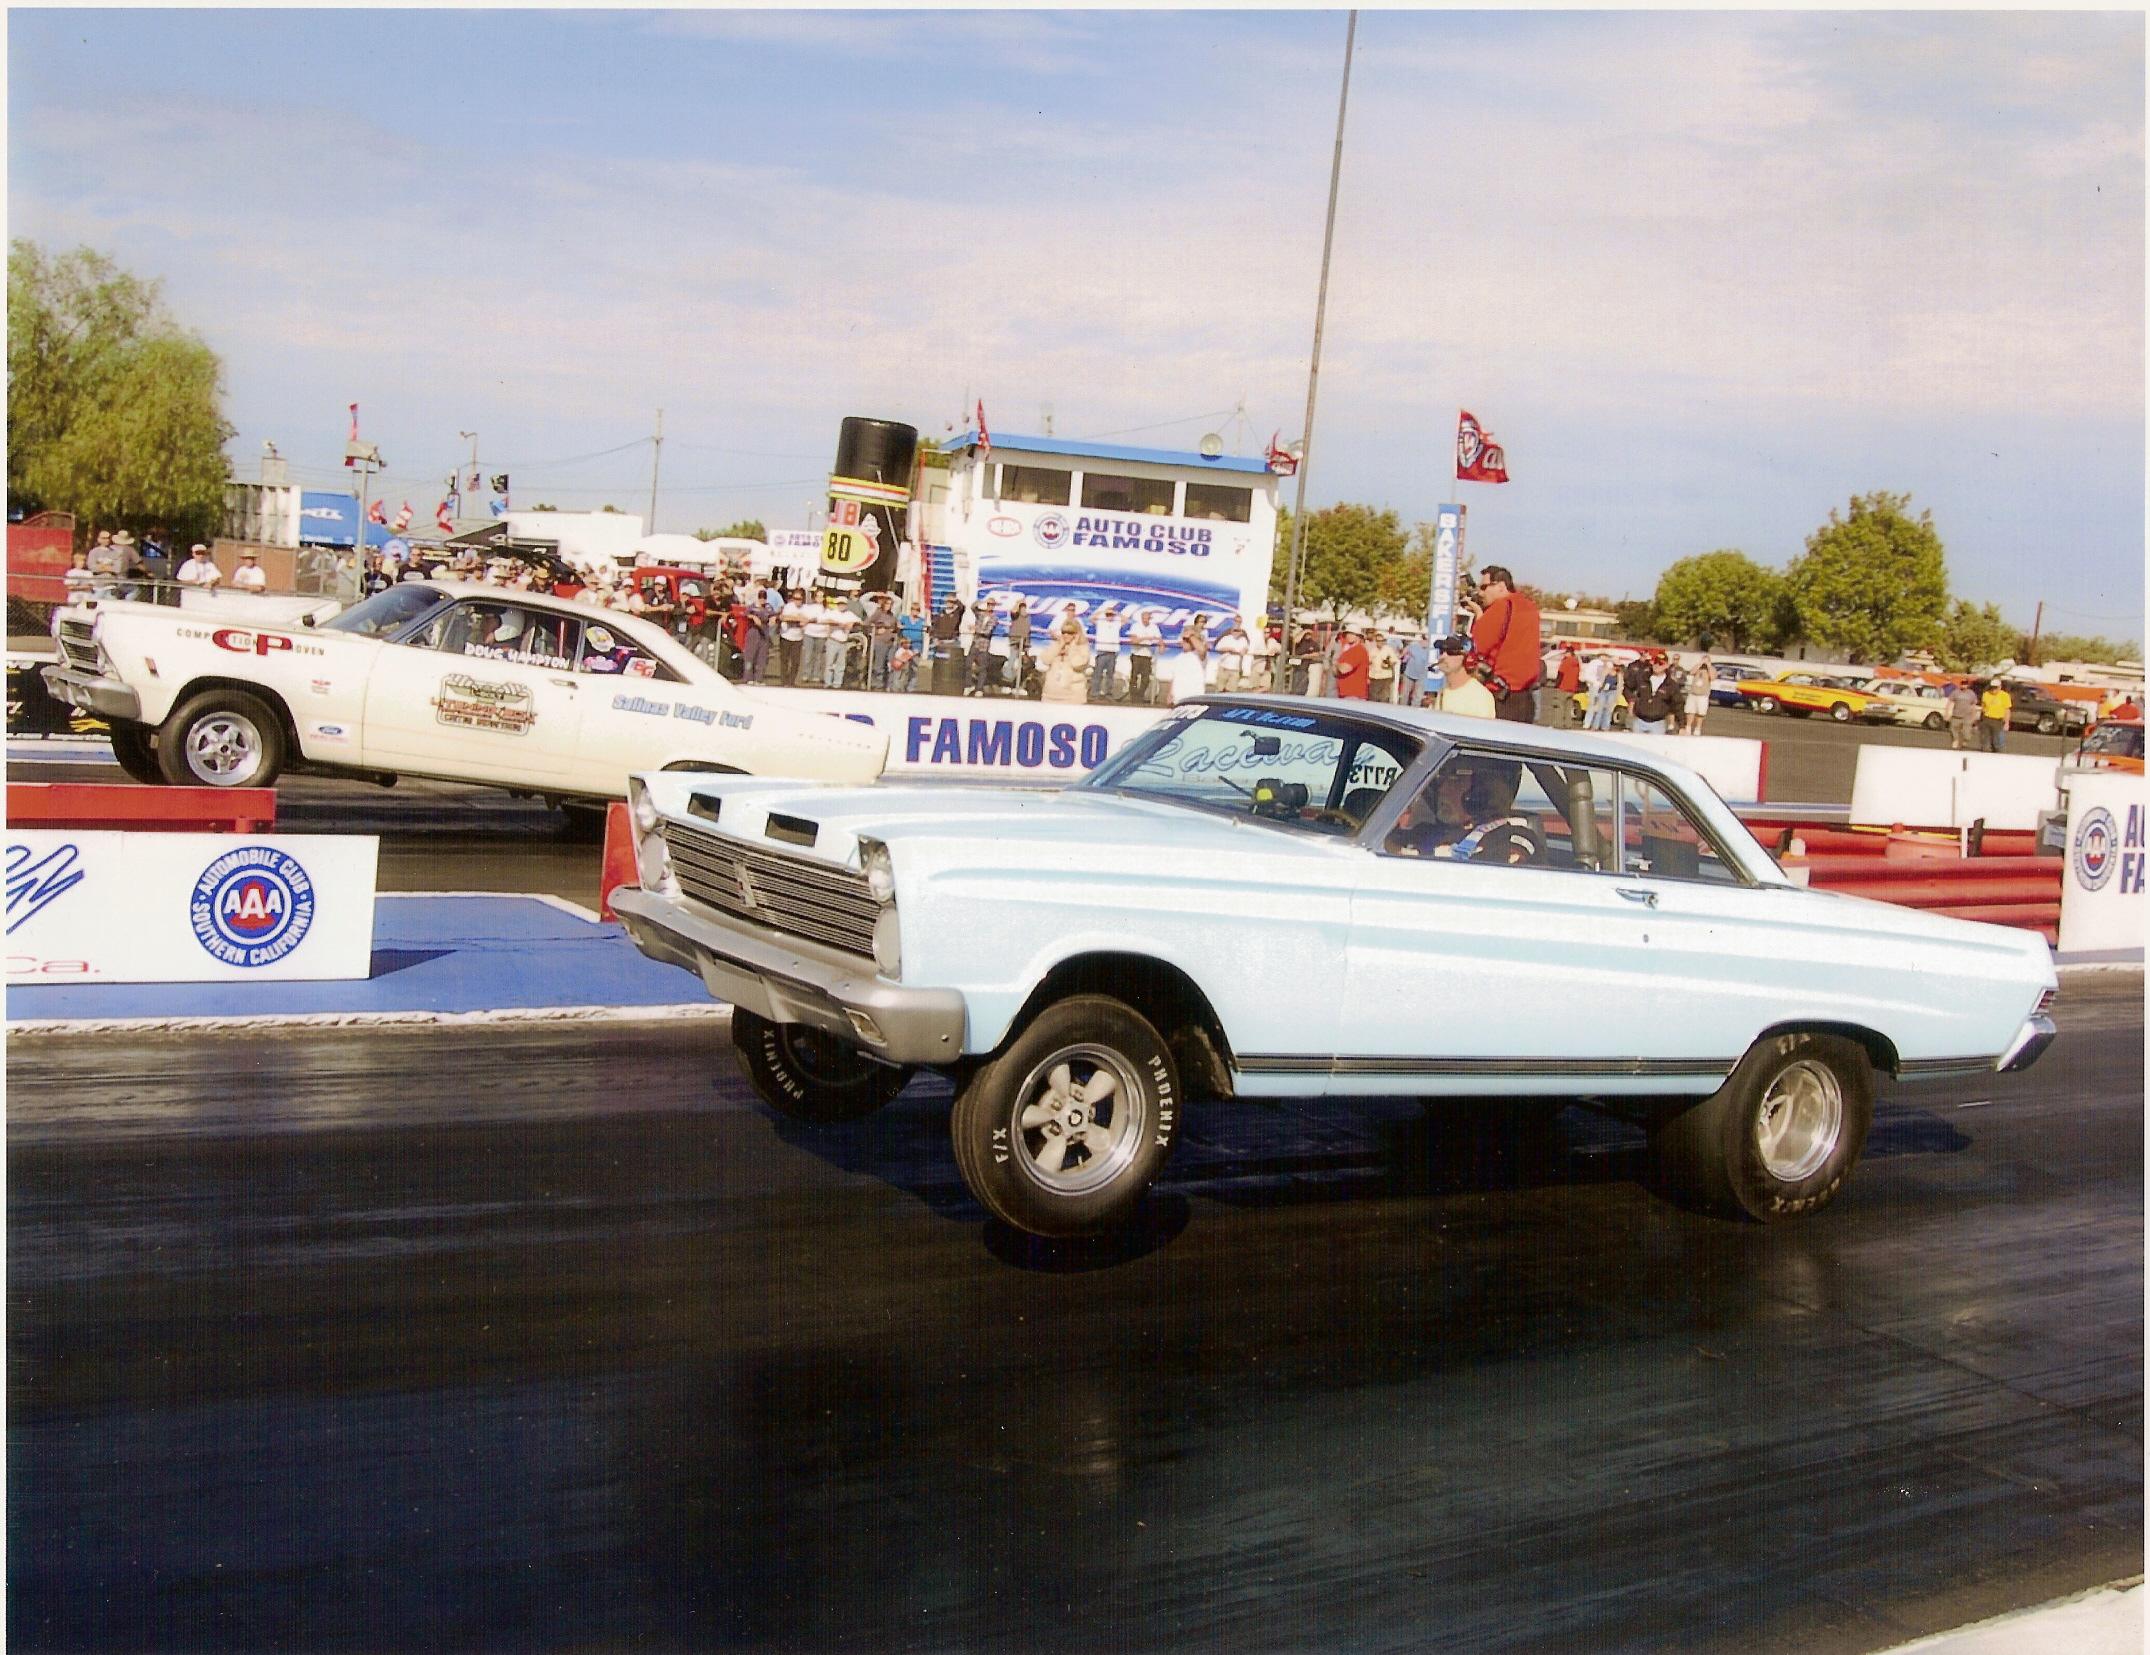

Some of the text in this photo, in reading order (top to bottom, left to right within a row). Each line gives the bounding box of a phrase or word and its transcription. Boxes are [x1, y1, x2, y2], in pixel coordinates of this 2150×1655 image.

[827, 532, 852, 562] 80
[1073, 531, 1211, 557] FAMOSO
[1075, 516, 1142, 537] AUTO
[1150, 524, 1212, 543] CLUB
[464, 641, 504, 660] DOUG
[507, 647, 570, 670] HAMPTON
[612, 694, 754, 730] Salinas Valley Ford
[905, 716, 1109, 770] FAMOSO
[2124, 804, 2145, 848] A
[197, 849, 310, 897] AUTOMOBILE CLUB
[223, 888, 283, 920] AAA
[192, 900, 312, 964] SOUTHERN CALIFORNIA
[1148, 1055, 1174, 1147] PHOENIX
[992, 1127, 1009, 1164] F/X
